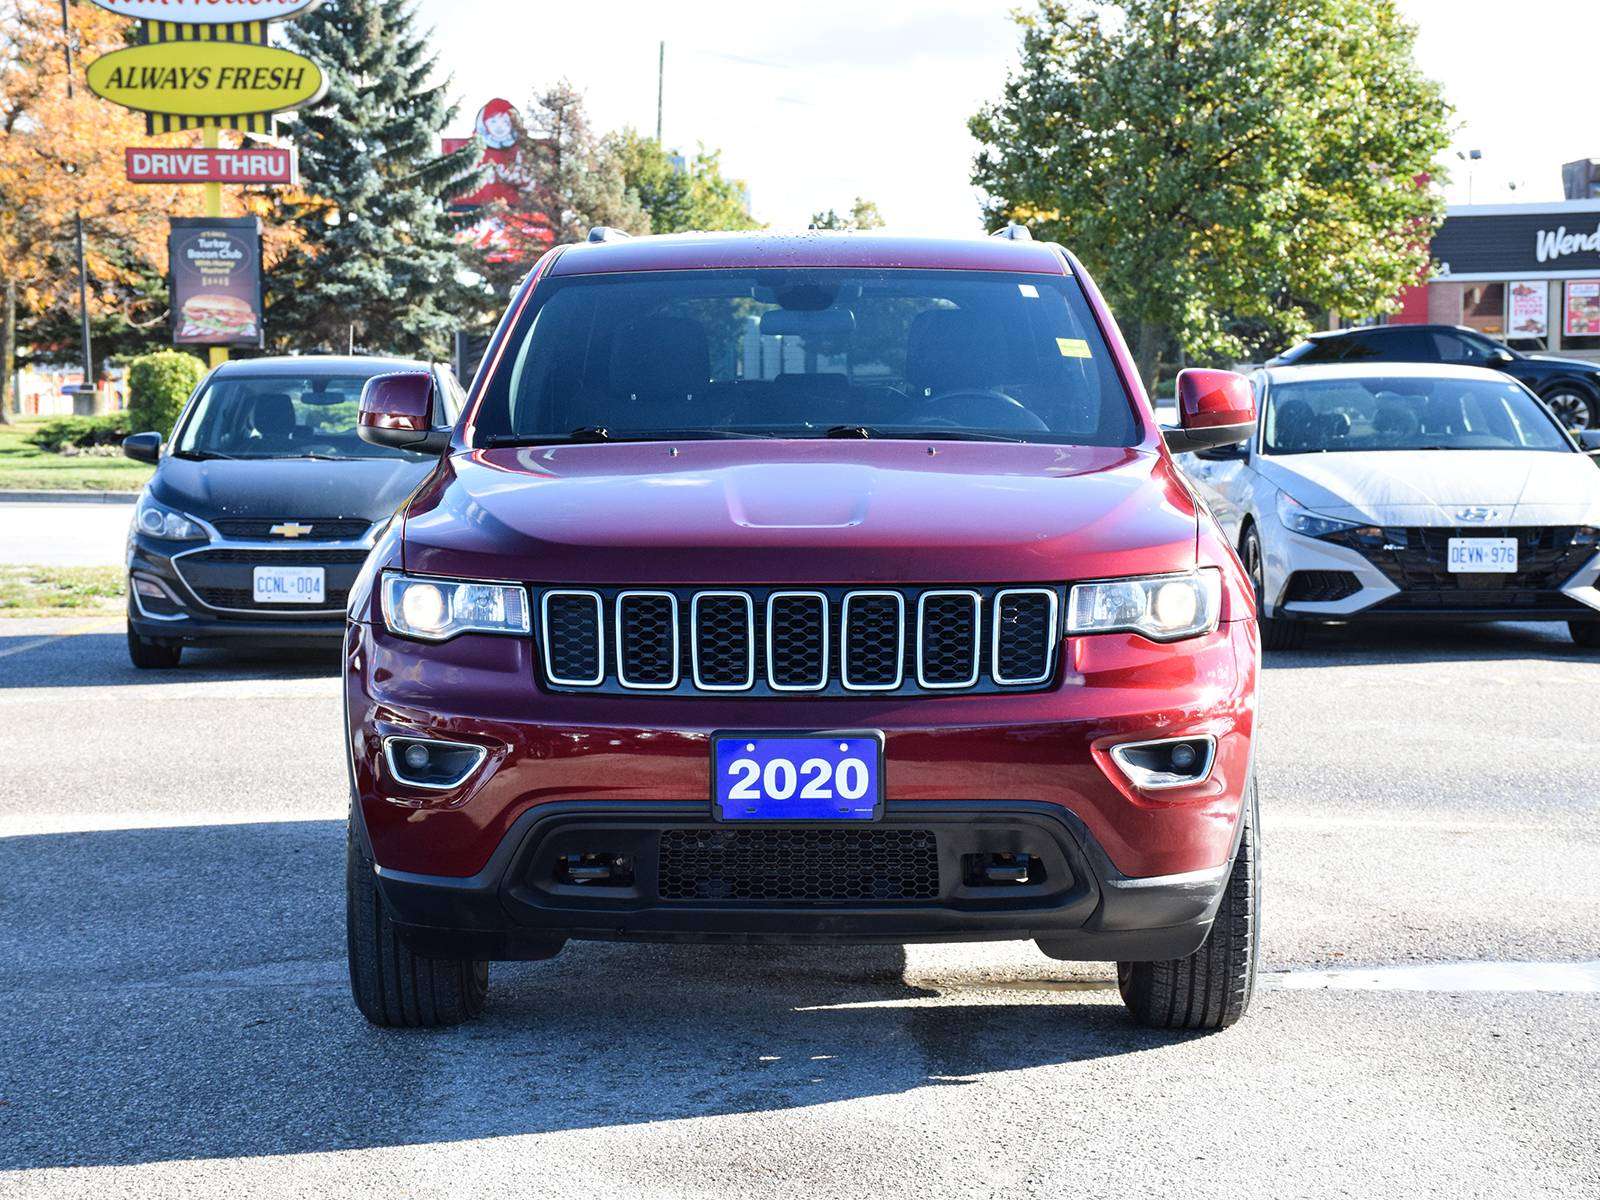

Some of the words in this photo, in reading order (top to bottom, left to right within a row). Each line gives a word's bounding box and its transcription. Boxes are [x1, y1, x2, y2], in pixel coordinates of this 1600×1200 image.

[105, 67, 211, 90] ALWAYS
[216, 67, 306, 90] FRESH
[133, 154, 209, 176] DRIVE
[215, 154, 286, 177] THRU
[198, 238, 231, 250] Turkey
[219, 248, 243, 259] Club
[1536, 223, 1600, 263] Wend
[728, 757, 869, 800] 2020
